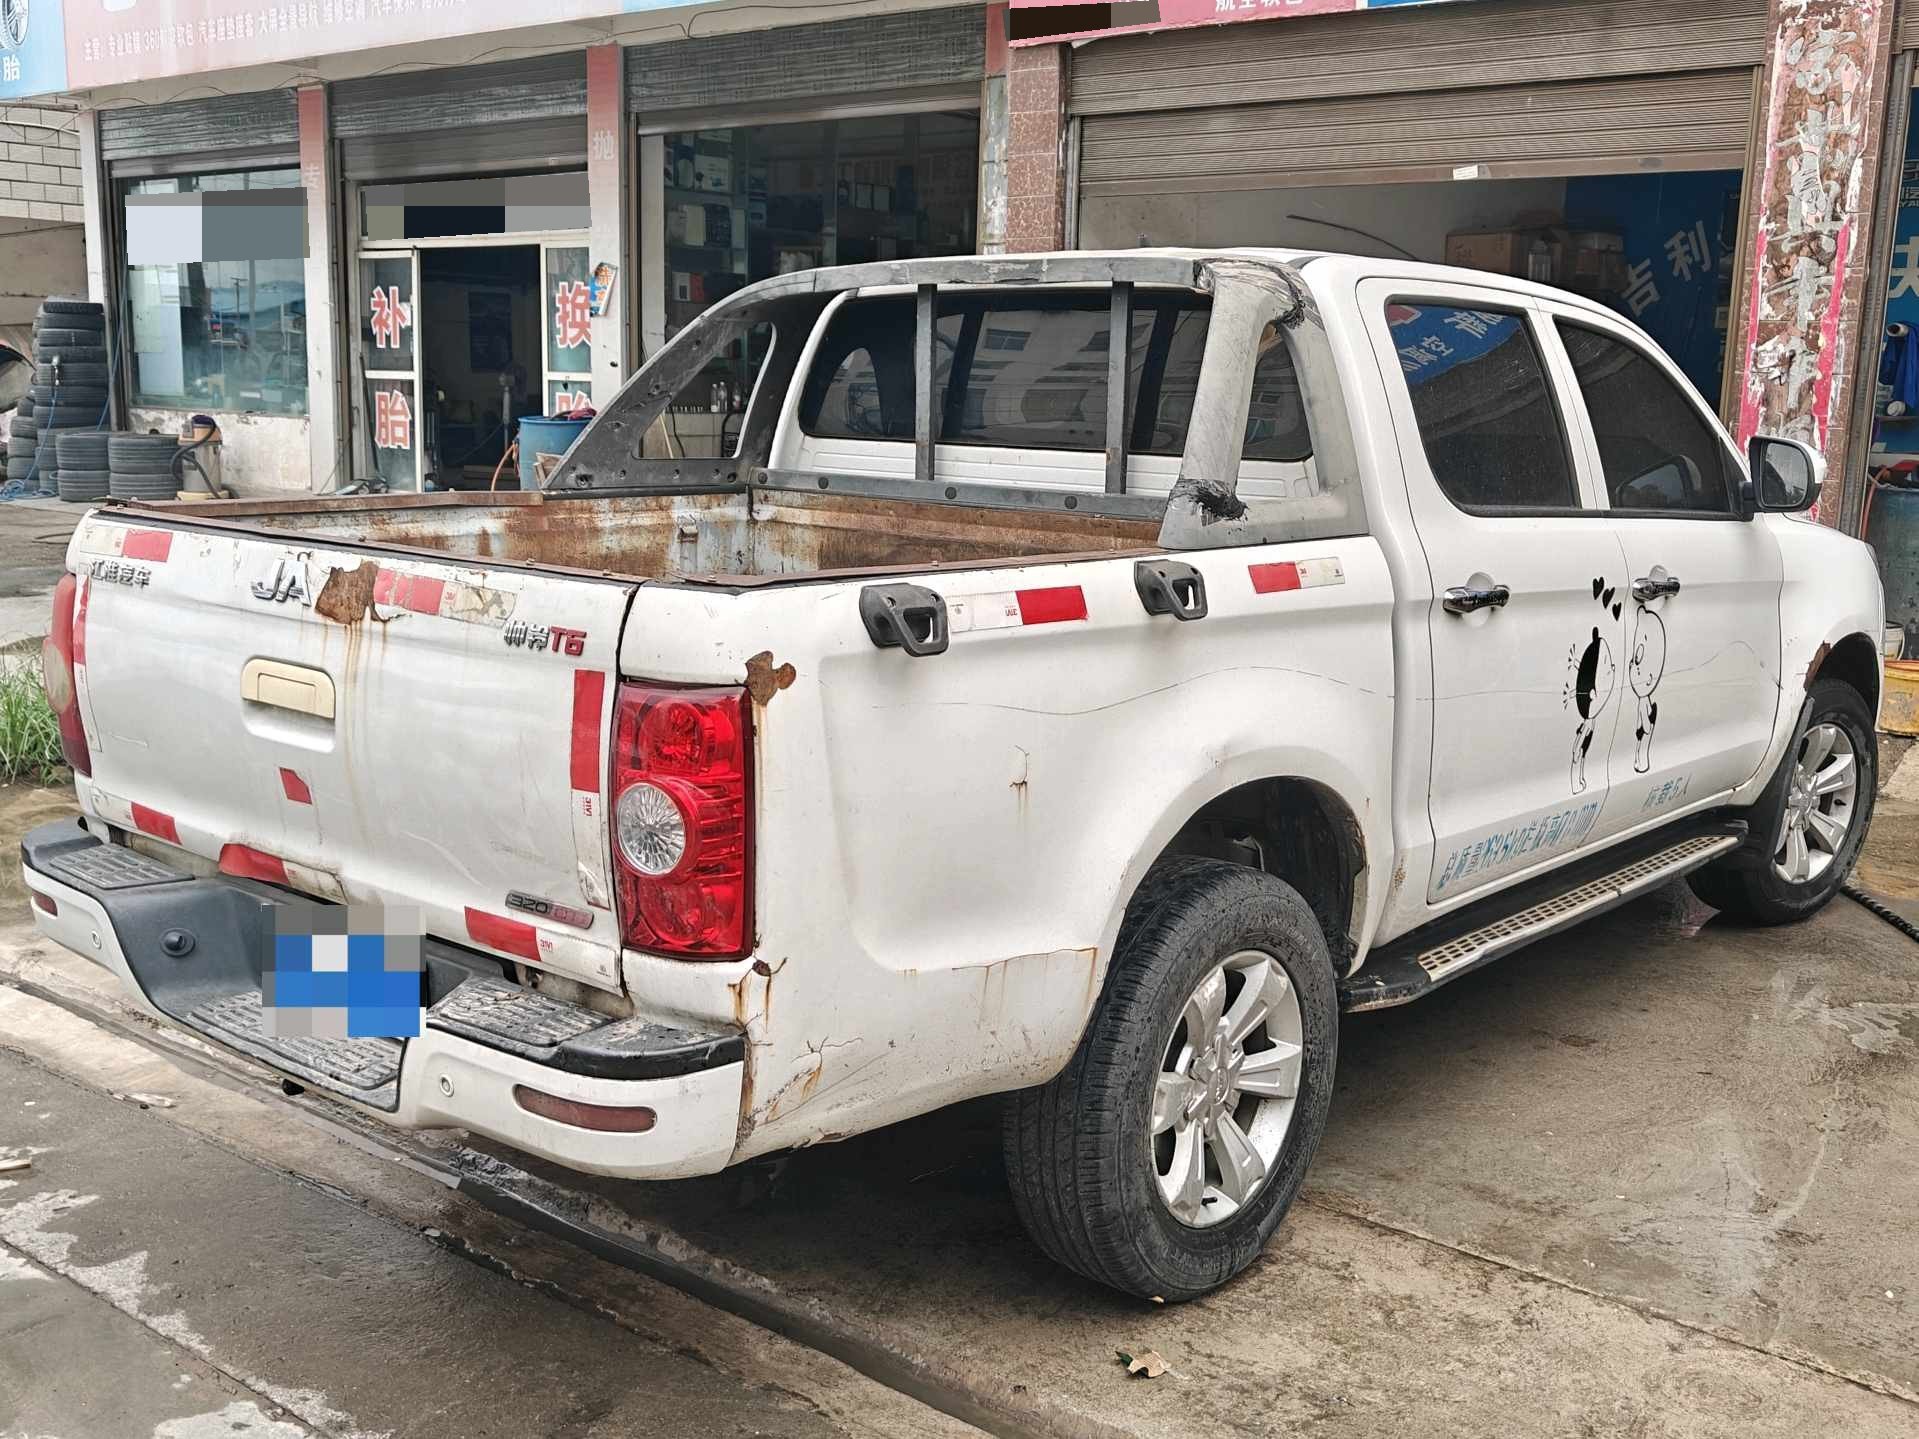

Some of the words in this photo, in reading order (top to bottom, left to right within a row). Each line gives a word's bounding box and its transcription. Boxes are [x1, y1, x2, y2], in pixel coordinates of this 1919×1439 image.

[2, 53, 21, 81] 胎
[1620, 219, 1713, 318] 吉利
[370, 286, 413, 450] 补胎
